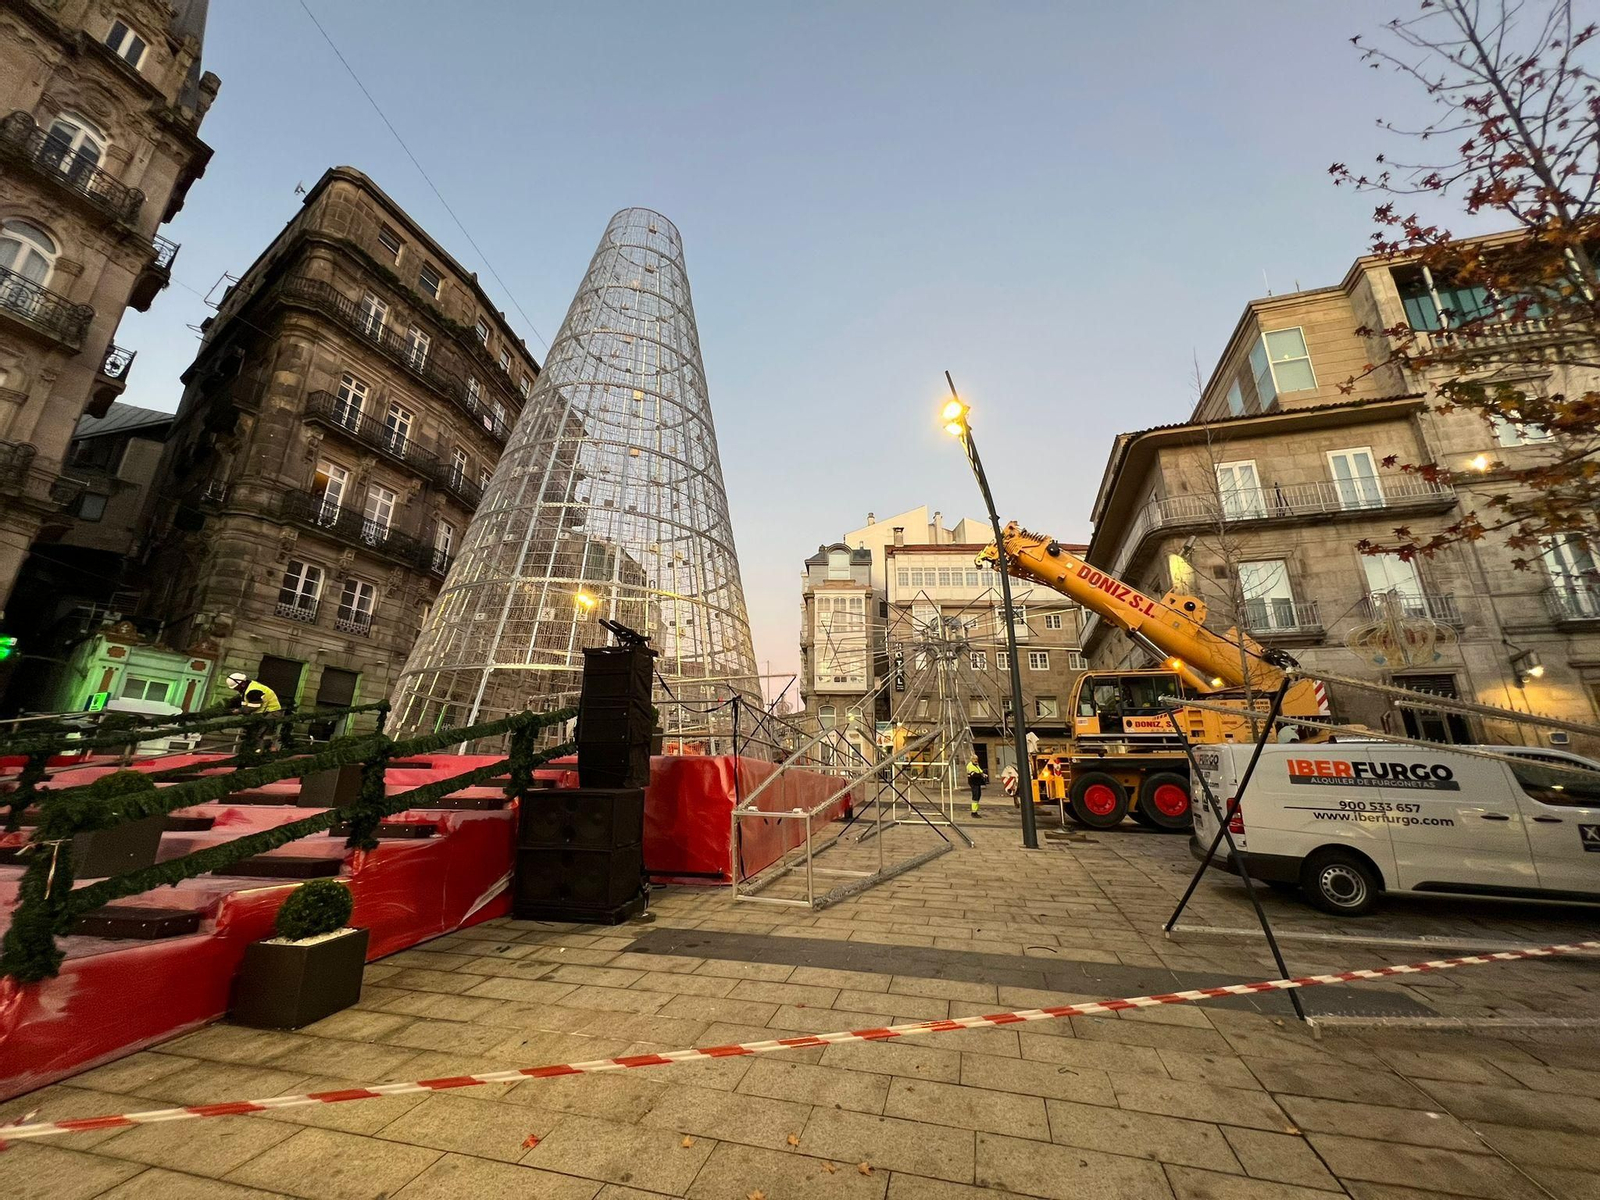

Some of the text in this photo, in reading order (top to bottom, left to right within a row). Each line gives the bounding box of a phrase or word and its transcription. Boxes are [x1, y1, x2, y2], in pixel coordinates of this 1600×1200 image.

[1077, 565, 1155, 618] DONIZ S.L.
[1287, 759, 1453, 781] IBERFURGO
[1311, 777, 1436, 788] ALQUILER DE FURGONETAS
[1339, 800, 1421, 813] 900 533 657
[1313, 811, 1454, 827] www.iberfurgo.com
